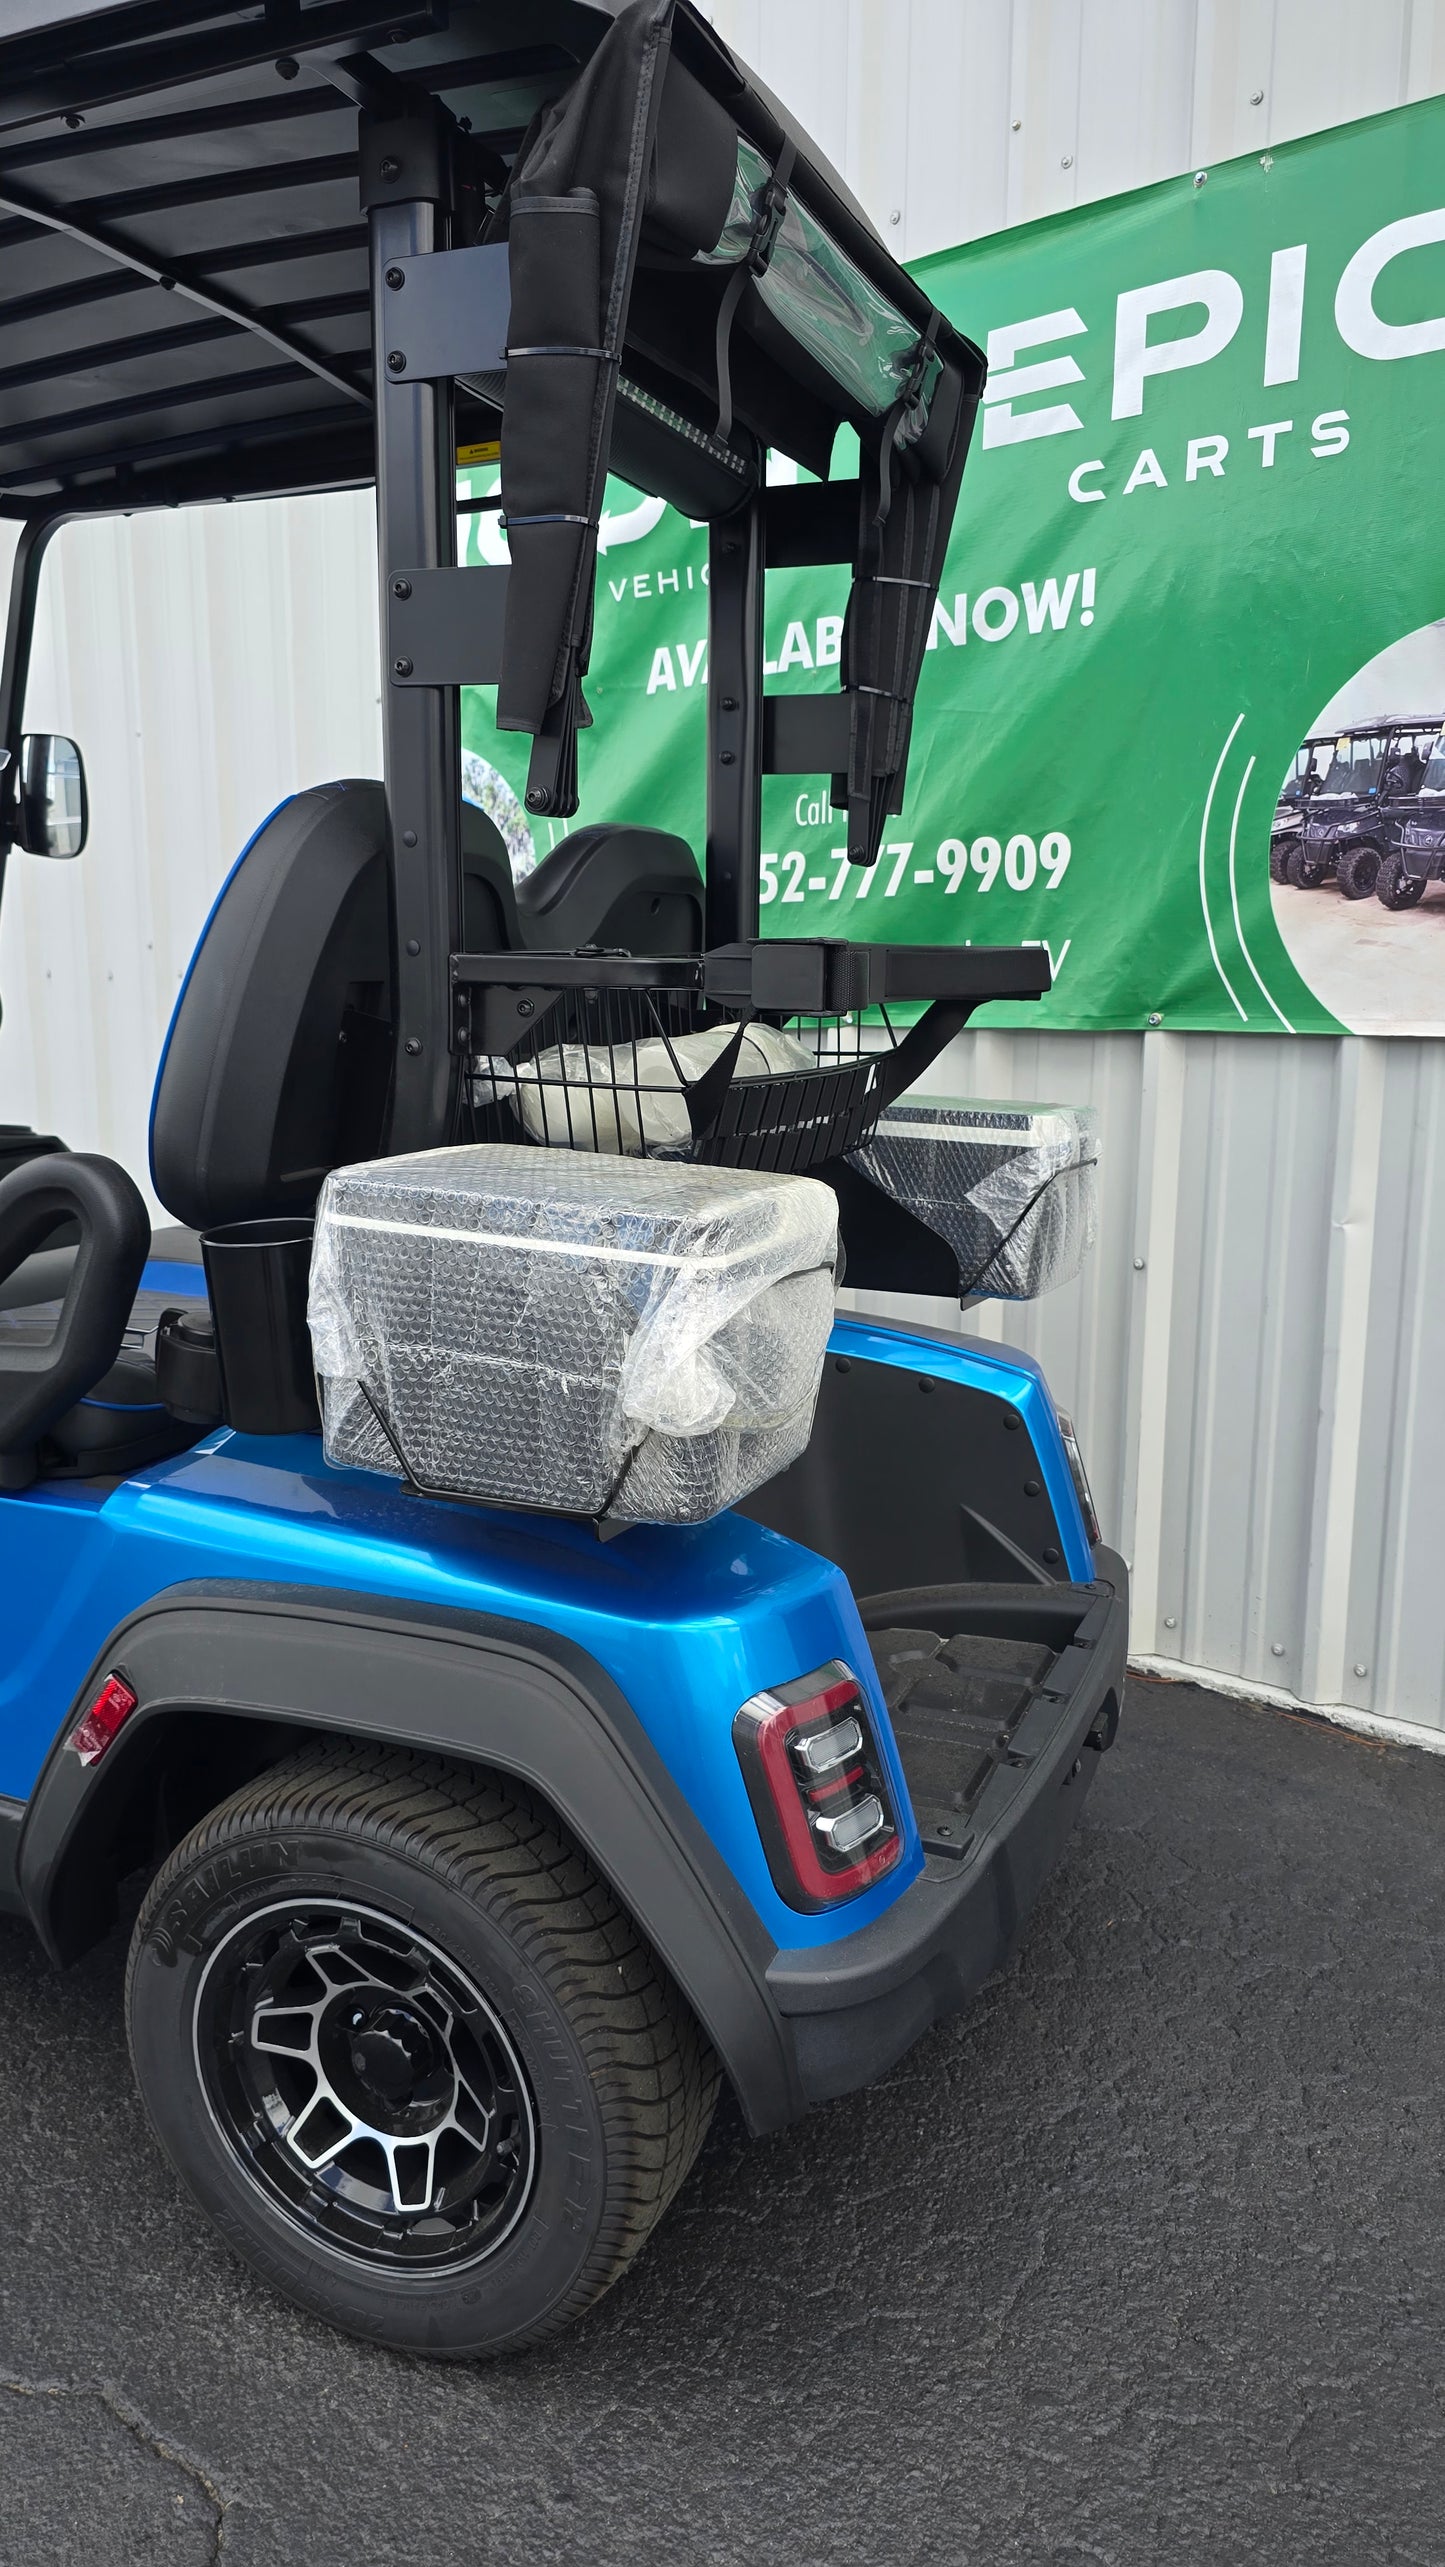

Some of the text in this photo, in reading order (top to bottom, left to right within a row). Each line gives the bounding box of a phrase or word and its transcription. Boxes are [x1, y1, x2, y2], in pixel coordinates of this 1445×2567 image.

[981, 207, 1445, 450] EPIC
[1067, 409, 1350, 503] CARTS
[925, 567, 1096, 650] NOW!
[759, 831, 1072, 905] 52-777-9909
